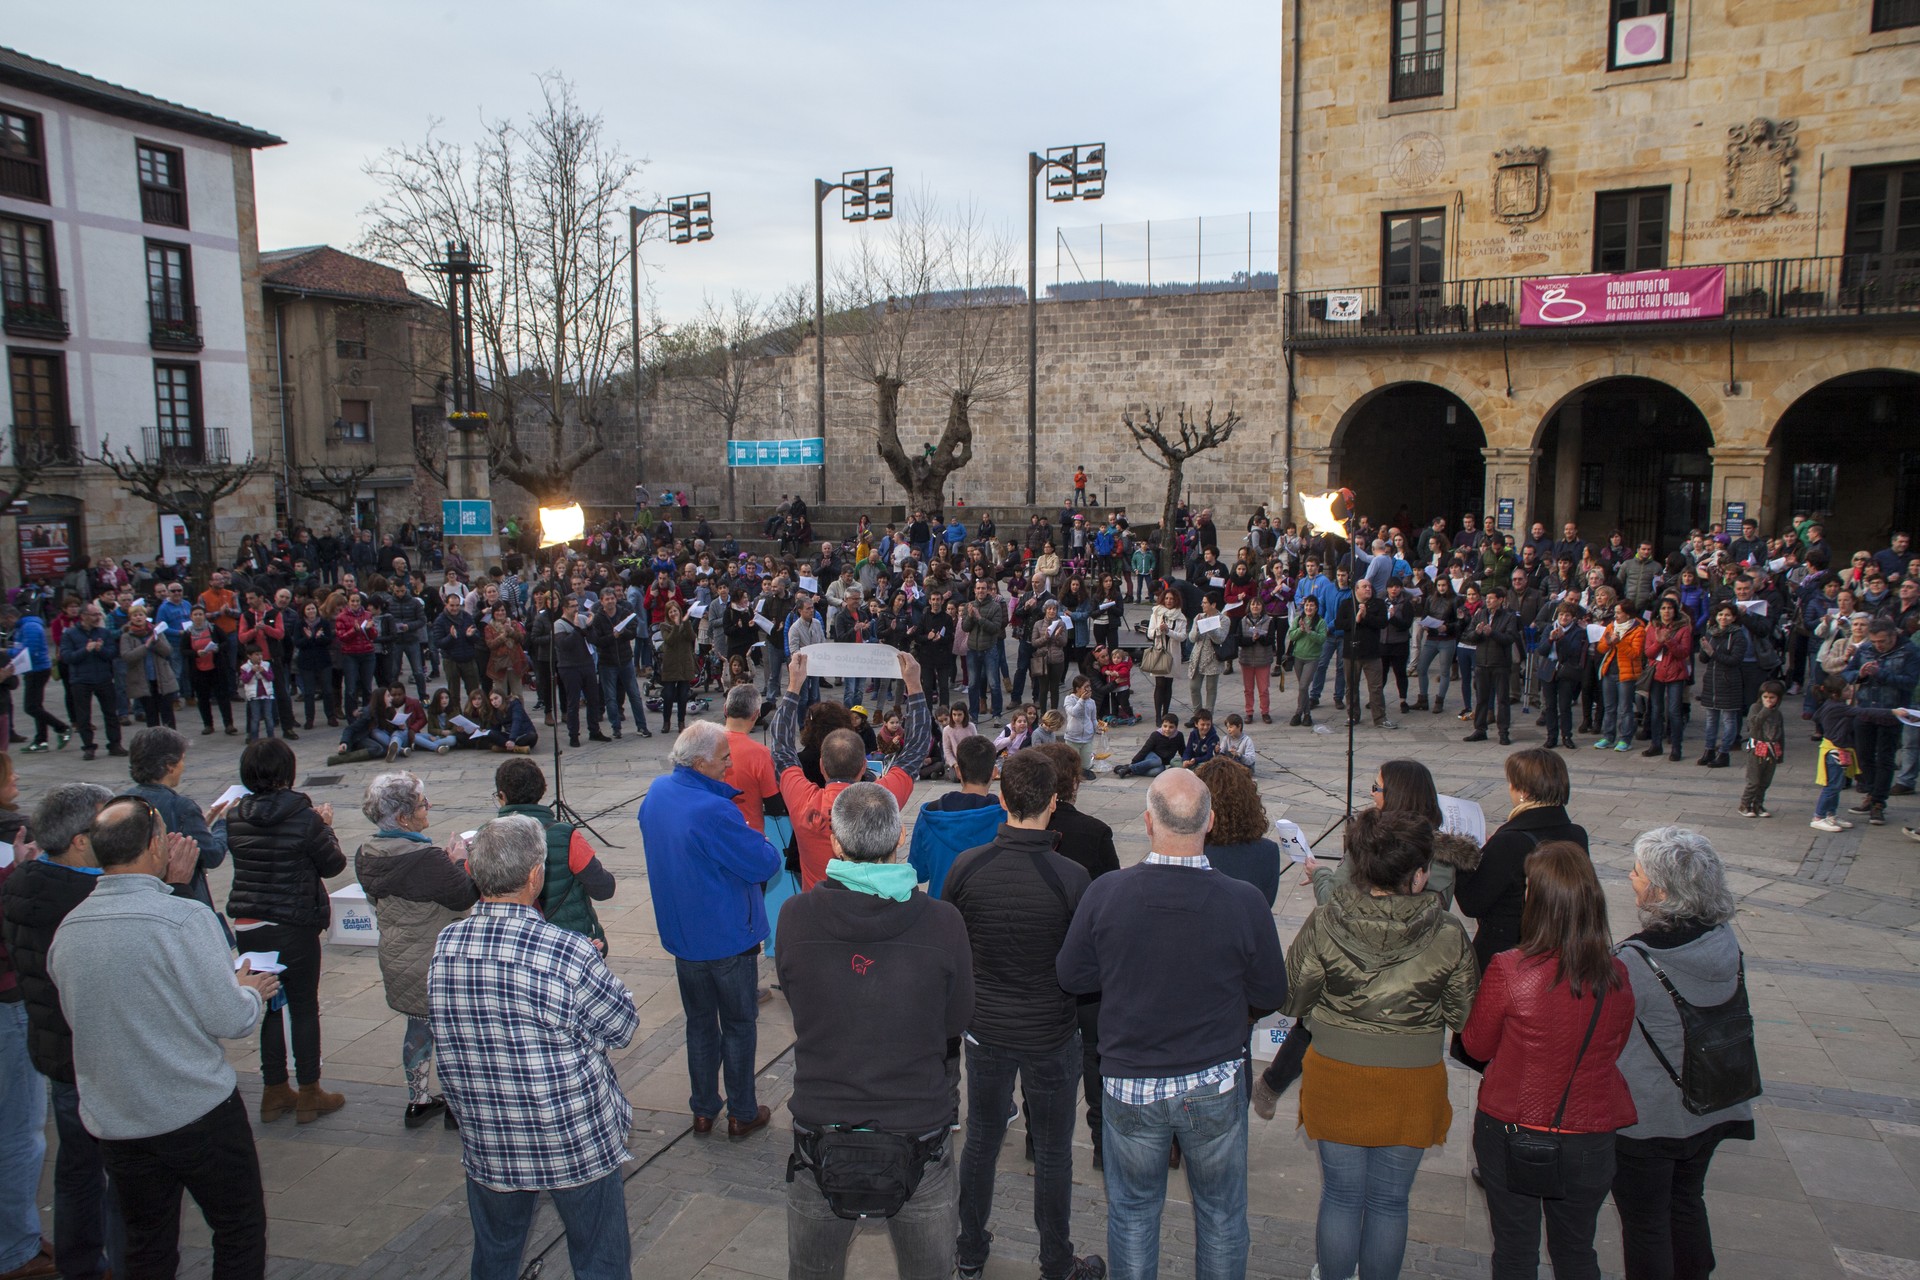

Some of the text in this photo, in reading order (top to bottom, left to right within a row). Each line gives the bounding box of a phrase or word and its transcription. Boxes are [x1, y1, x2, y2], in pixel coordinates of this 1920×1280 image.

[1607, 278, 1669, 294] emakumearen
[1606, 291, 1690, 310] nazioarteko eguna
